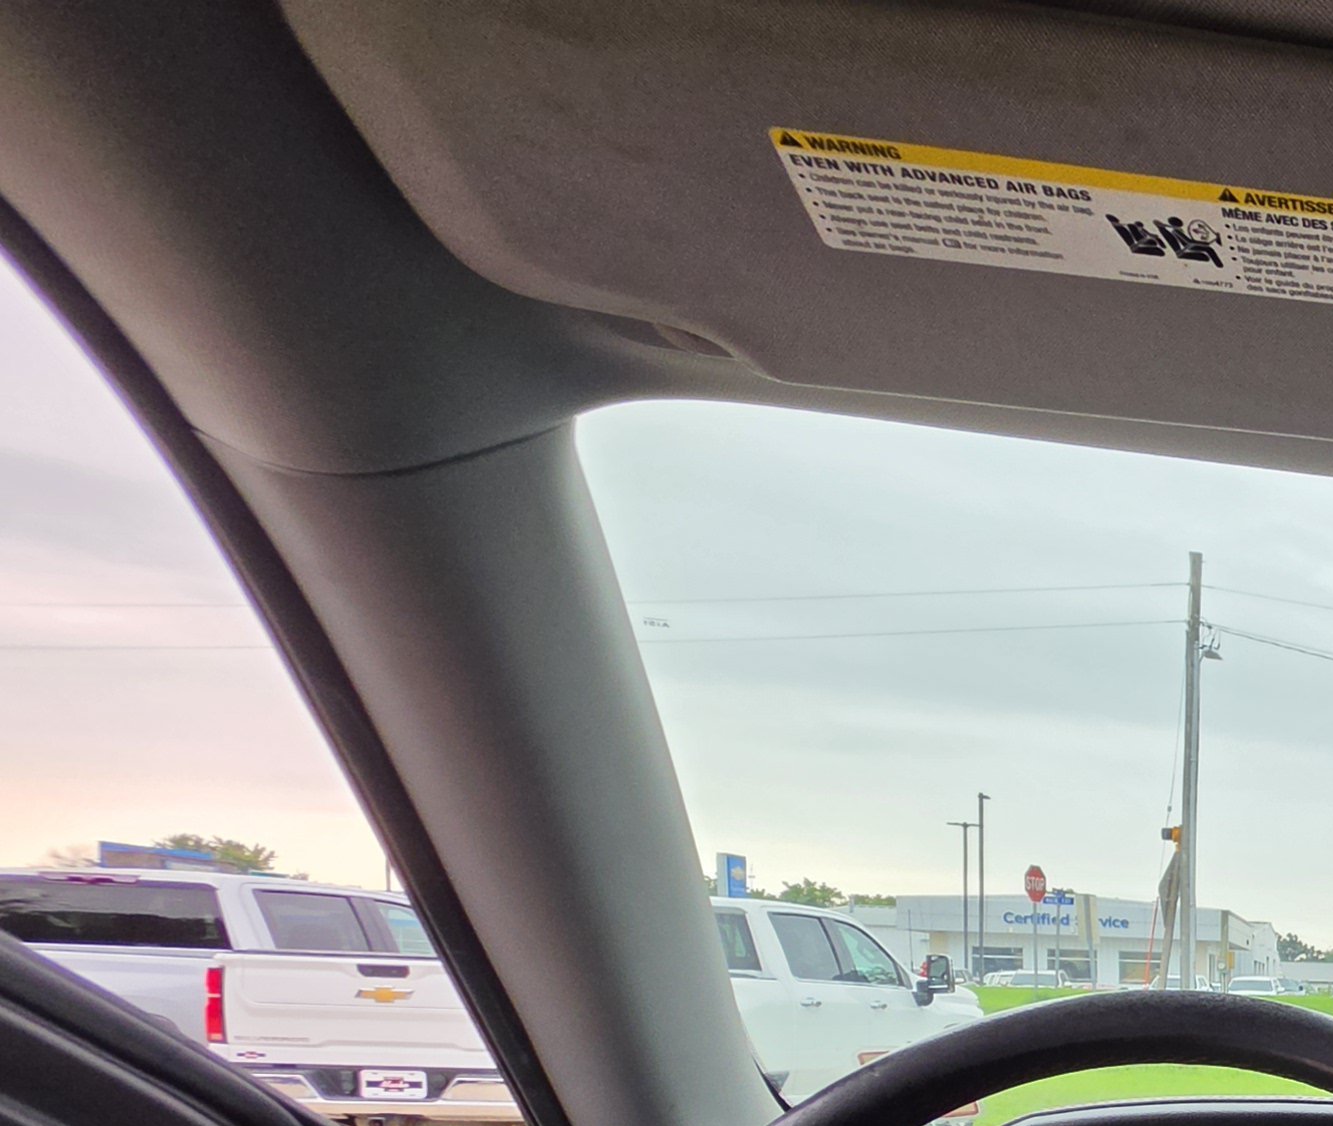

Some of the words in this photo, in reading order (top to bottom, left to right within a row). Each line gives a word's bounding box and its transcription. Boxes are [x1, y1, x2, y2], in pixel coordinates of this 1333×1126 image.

[804, 134, 901, 160] WARNING
[788, 152, 840, 171] EVEN
[843, 159, 894, 177] WITH
[900, 166, 999, 190] ADVANCED
[1005, 180, 1038, 195] AIR
[1041, 184, 1091, 202] BAGS
[1221, 205, 1262, 222] MÊME
[1264, 212, 1298, 227] AVEC
[1301, 217, 1328, 230] DES
[1025, 876, 1044, 890] STOP
